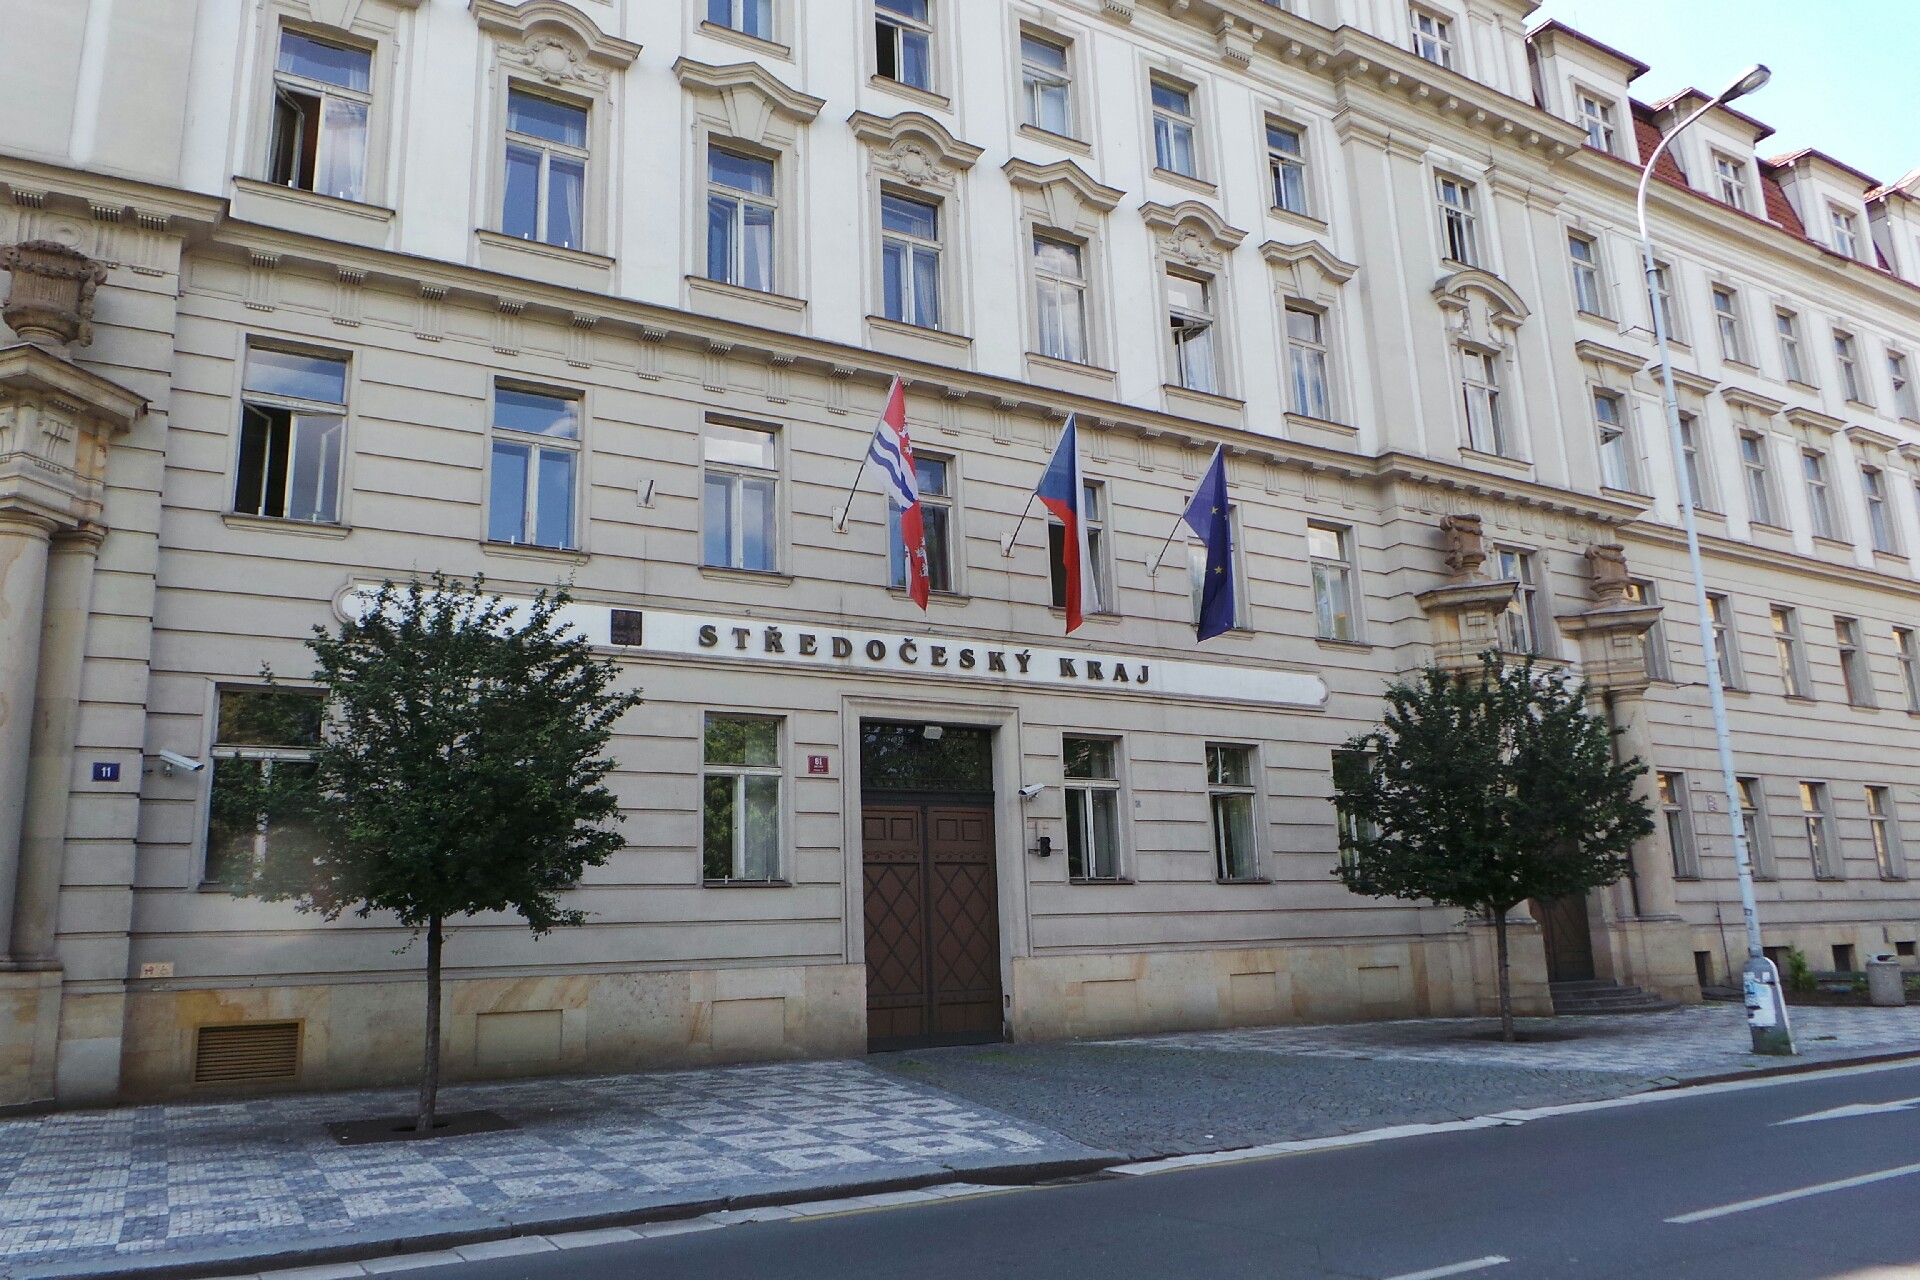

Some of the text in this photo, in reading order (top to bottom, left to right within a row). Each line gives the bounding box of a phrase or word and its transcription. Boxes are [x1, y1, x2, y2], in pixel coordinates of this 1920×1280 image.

[699, 625, 1149, 684] STŘEDOČESKÝ KRAJ
[101, 766, 111, 778] 11
